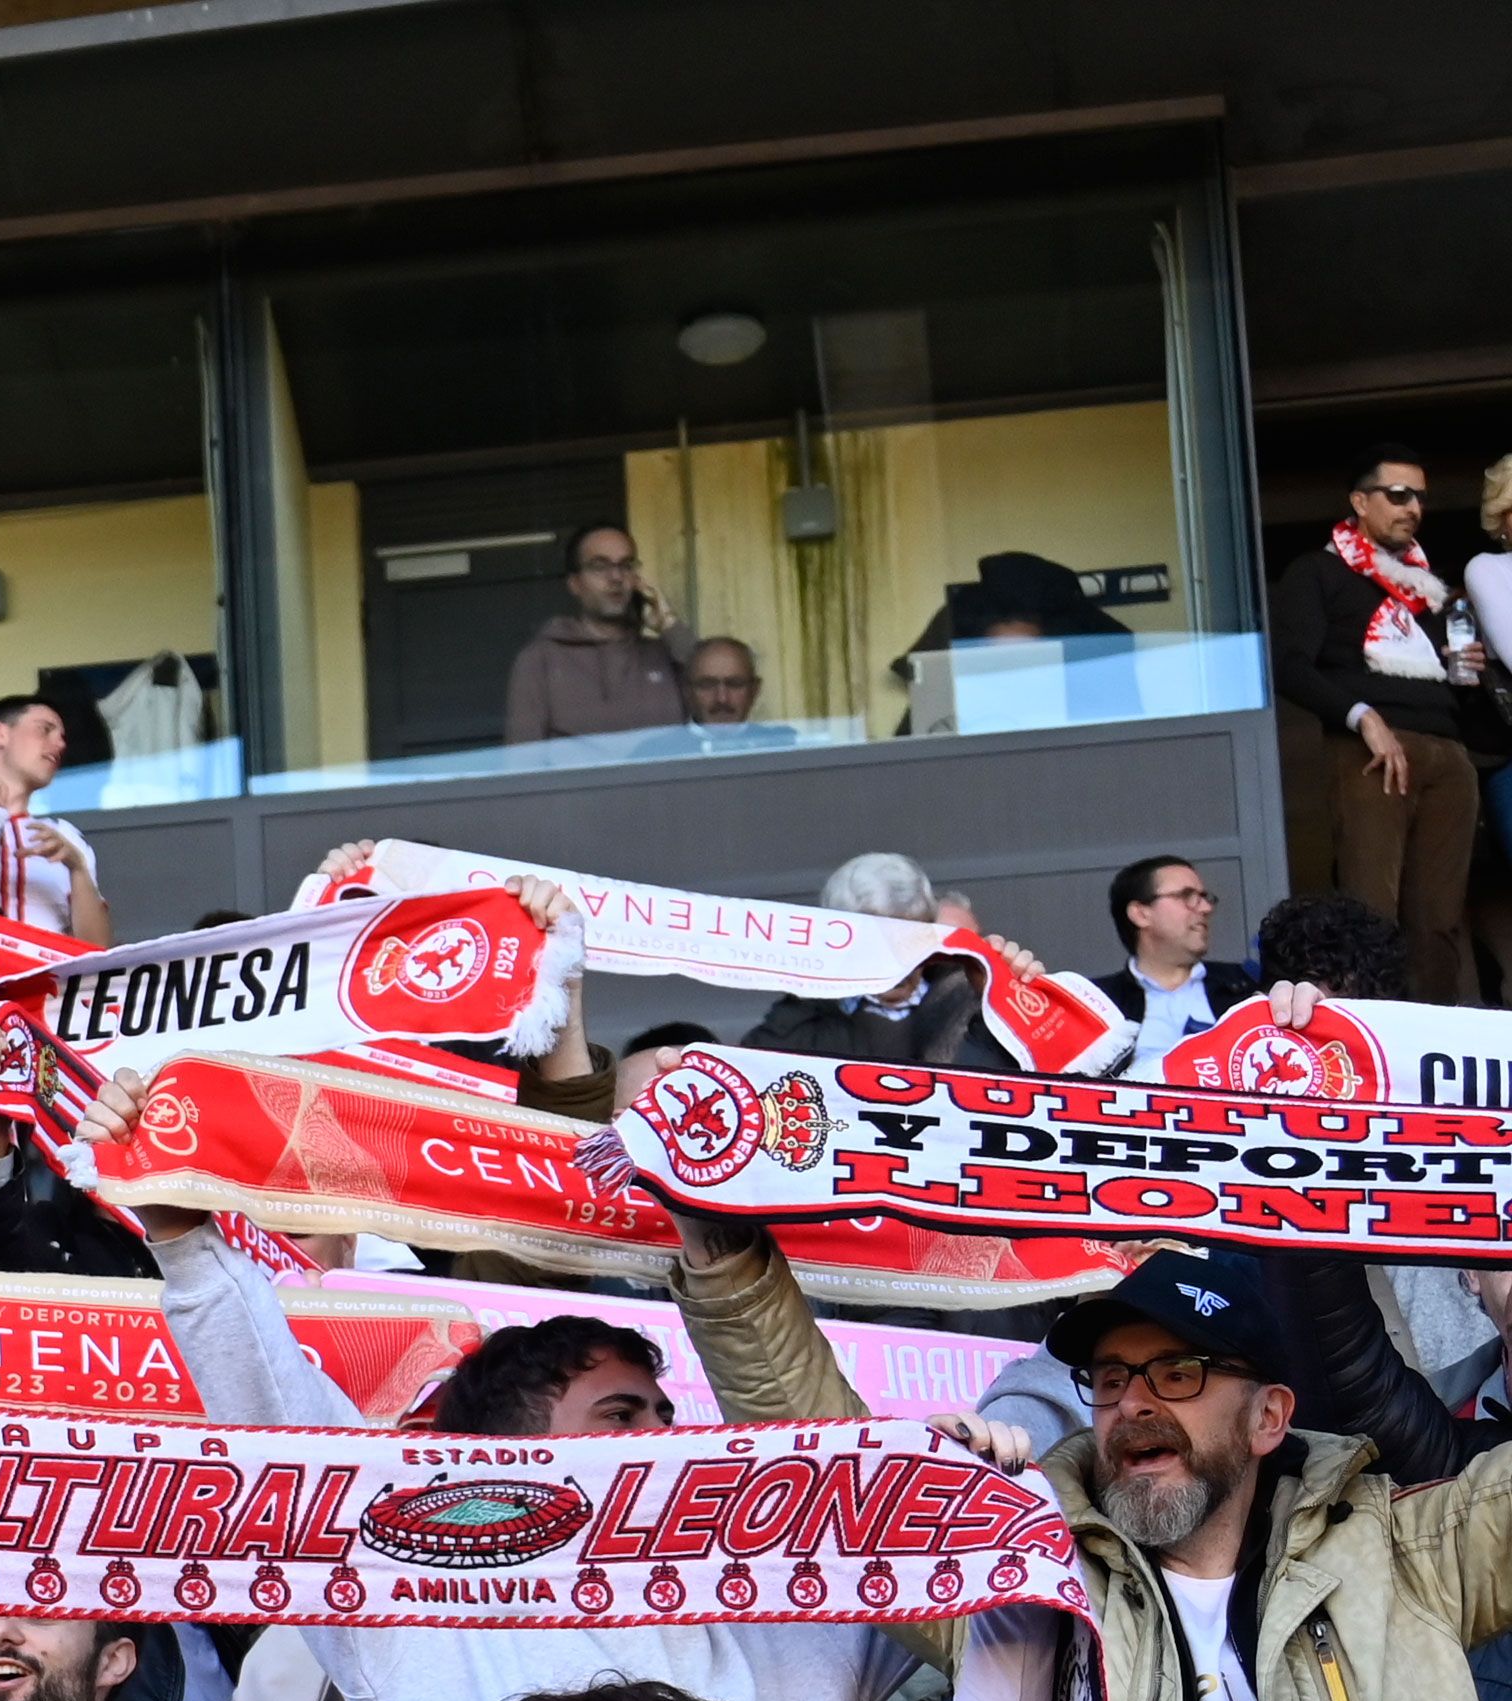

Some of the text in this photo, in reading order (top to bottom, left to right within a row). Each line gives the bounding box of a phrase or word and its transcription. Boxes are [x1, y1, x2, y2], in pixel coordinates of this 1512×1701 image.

[493, 935, 521, 980] 1923
[57, 942, 311, 1042] LEONESA
[835, 1062, 1512, 1149] CULTUR
[451, 1117, 571, 1154] CULTURAL
[857, 1110, 1512, 1185] Y DEPORT
[833, 1149, 1512, 1242] LEONE
[265, 1199, 348, 1220] DEPORTIVA
[351, 1207, 417, 1229] HISTORIA
[418, 1217, 482, 1236] LEONESA
[484, 1226, 517, 1244] ALMA
[563, 1199, 640, 1231] 1923
[60, 1286, 146, 1302] DEPORTIVA
[890, 1281, 956, 1295] CULTURAL
[19, 1306, 161, 1330] DEPORTIVA
[291, 1299, 470, 1316] ALMA CULTURAL ESENCIA
[92, 1380, 184, 1405] 2023
[1, 1422, 950, 1458] AUPA CULT
[400, 1446, 555, 1468] ESTADIO
[574, 1453, 1078, 1566] LEONESA
[389, 1576, 559, 1605] AMILIVIA
